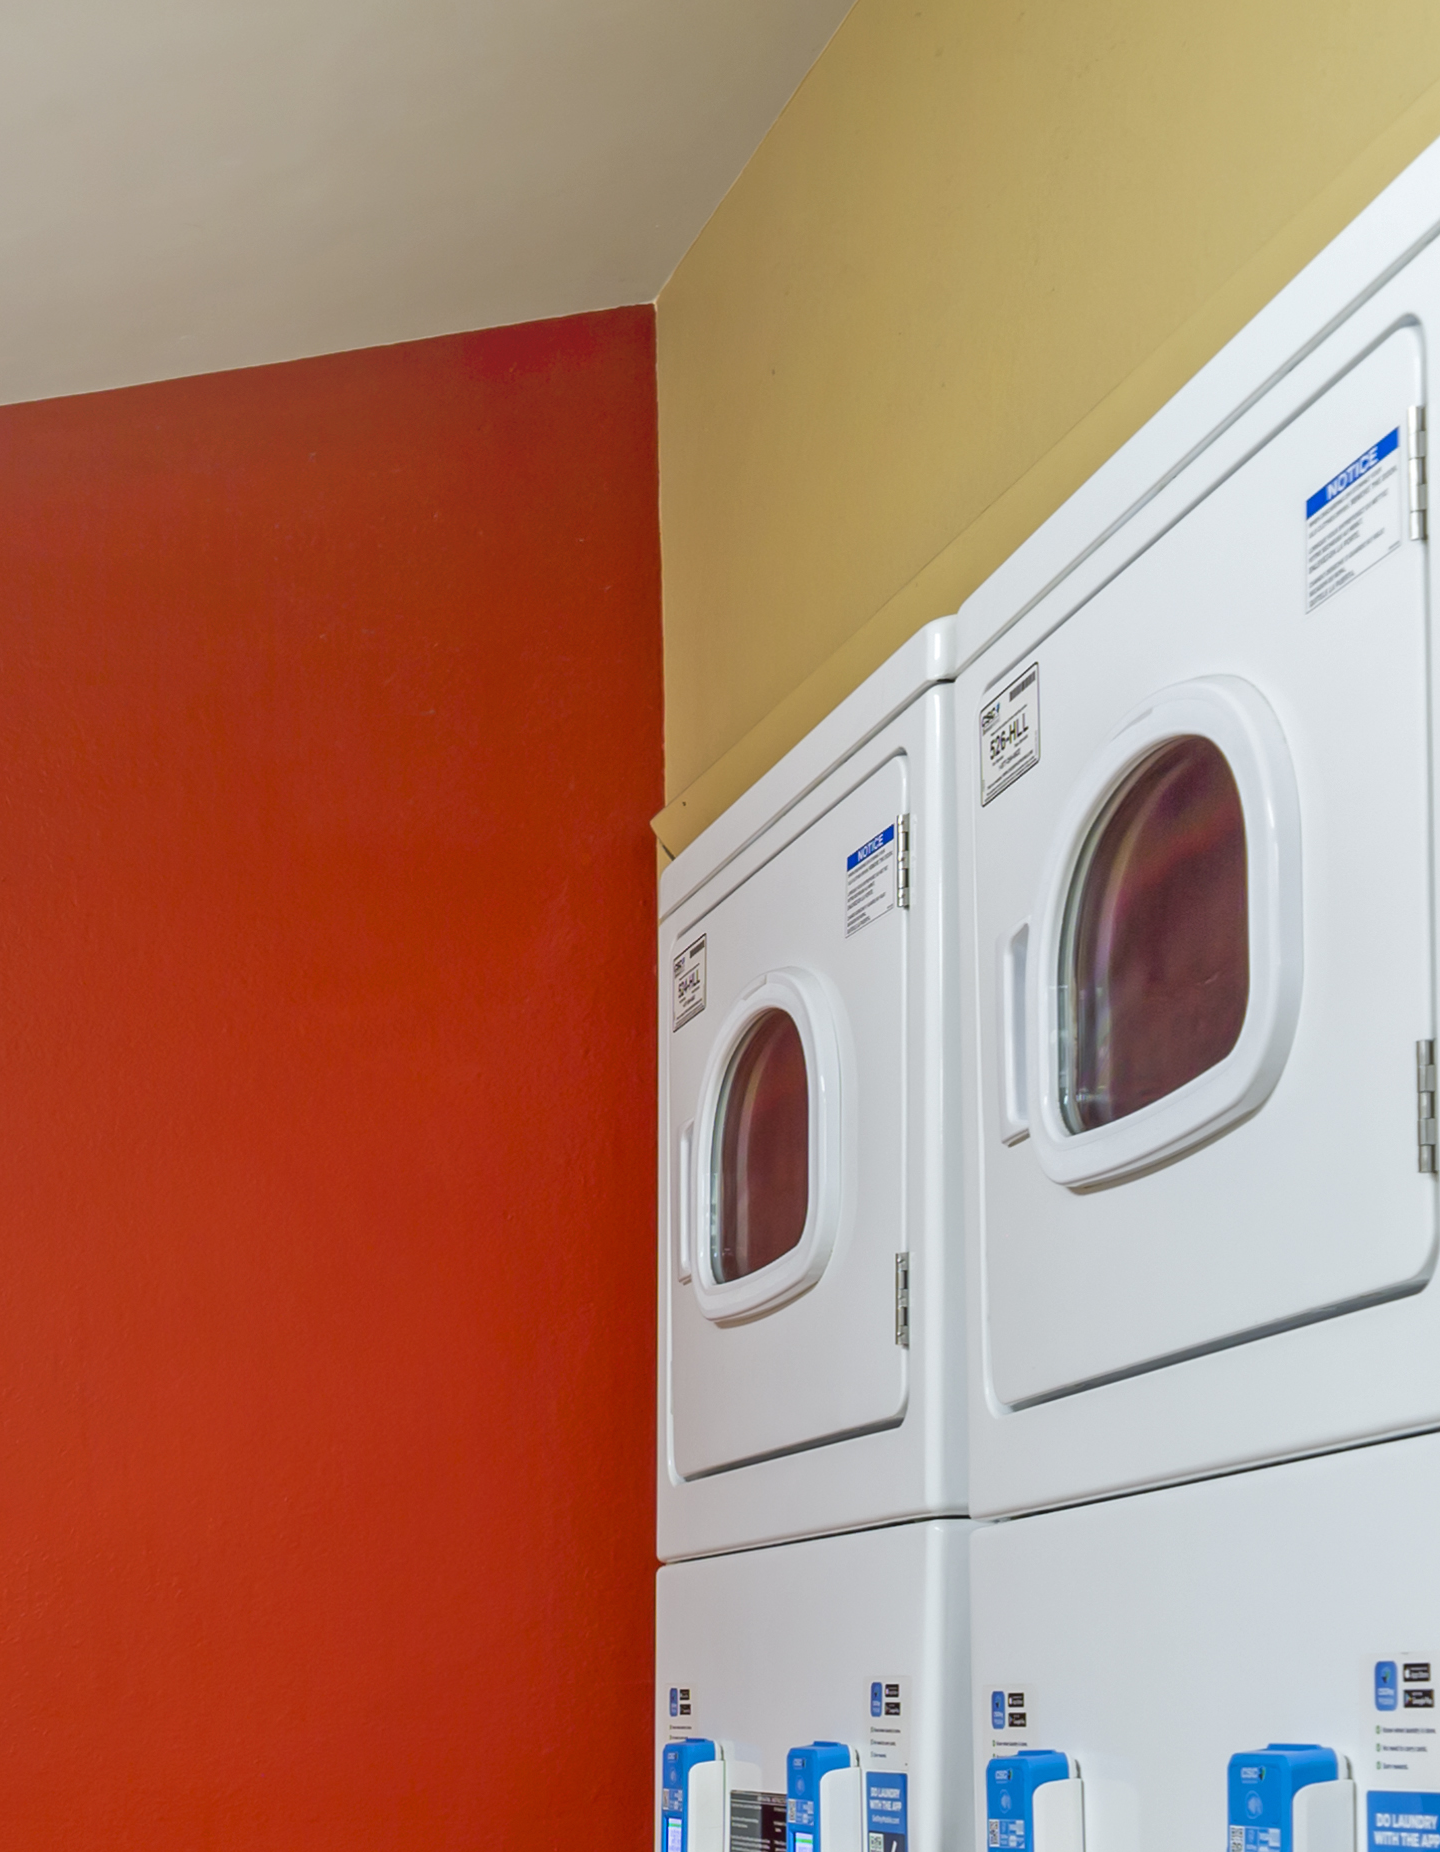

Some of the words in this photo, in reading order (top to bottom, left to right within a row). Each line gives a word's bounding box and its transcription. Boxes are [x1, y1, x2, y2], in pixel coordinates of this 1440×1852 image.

[1326, 446, 1379, 500] NOTICE
[858, 833, 884, 861] NOTICE
[1375, 1813, 1391, 1828] DO
[1392, 1814, 1438, 1830] LAUNDRY
[1373, 1830, 1400, 1846] WITH
[1400, 1832, 1420, 1847] THE
